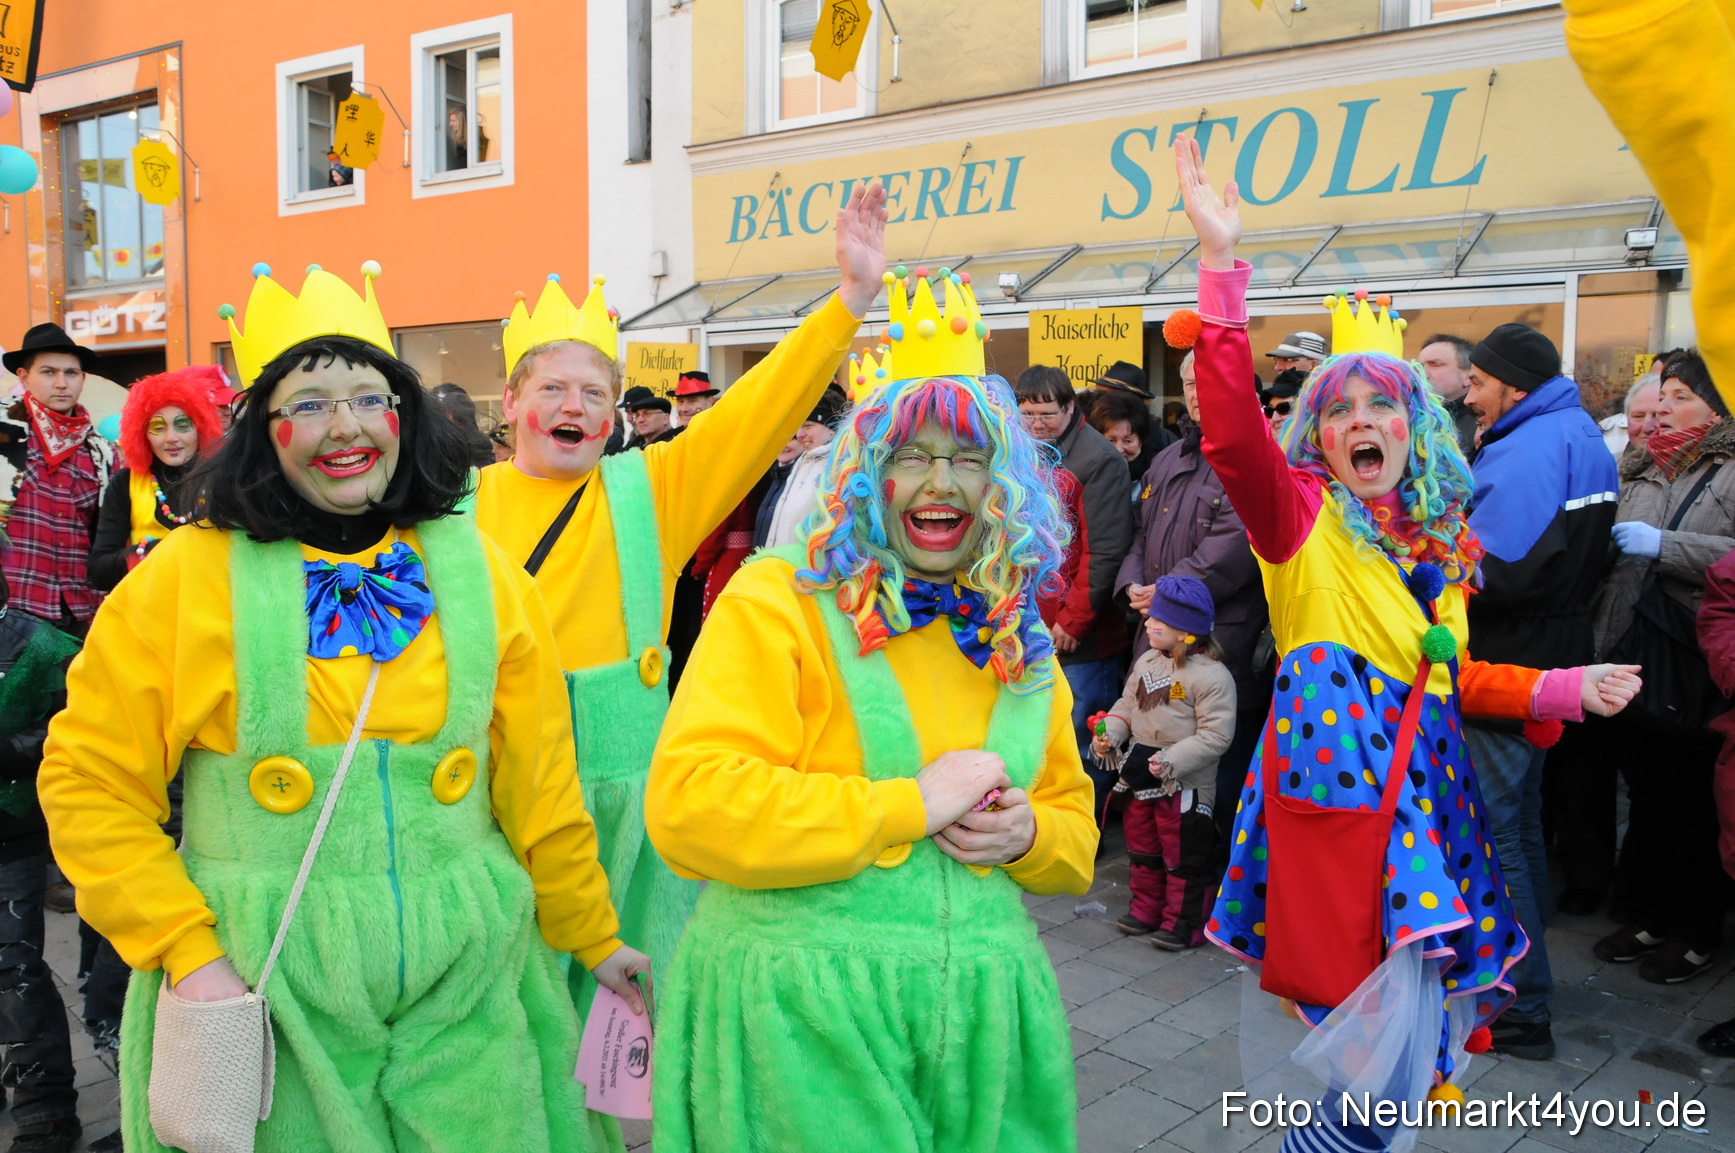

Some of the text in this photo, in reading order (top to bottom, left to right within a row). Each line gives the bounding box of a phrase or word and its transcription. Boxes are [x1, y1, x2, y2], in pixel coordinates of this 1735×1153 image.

[1101, 87, 1488, 222] STOLL
[65, 301, 167, 338] GÖTZ
[1041, 312, 1130, 342] Kaiserliche
[1056, 354, 1111, 387] Krapfe
